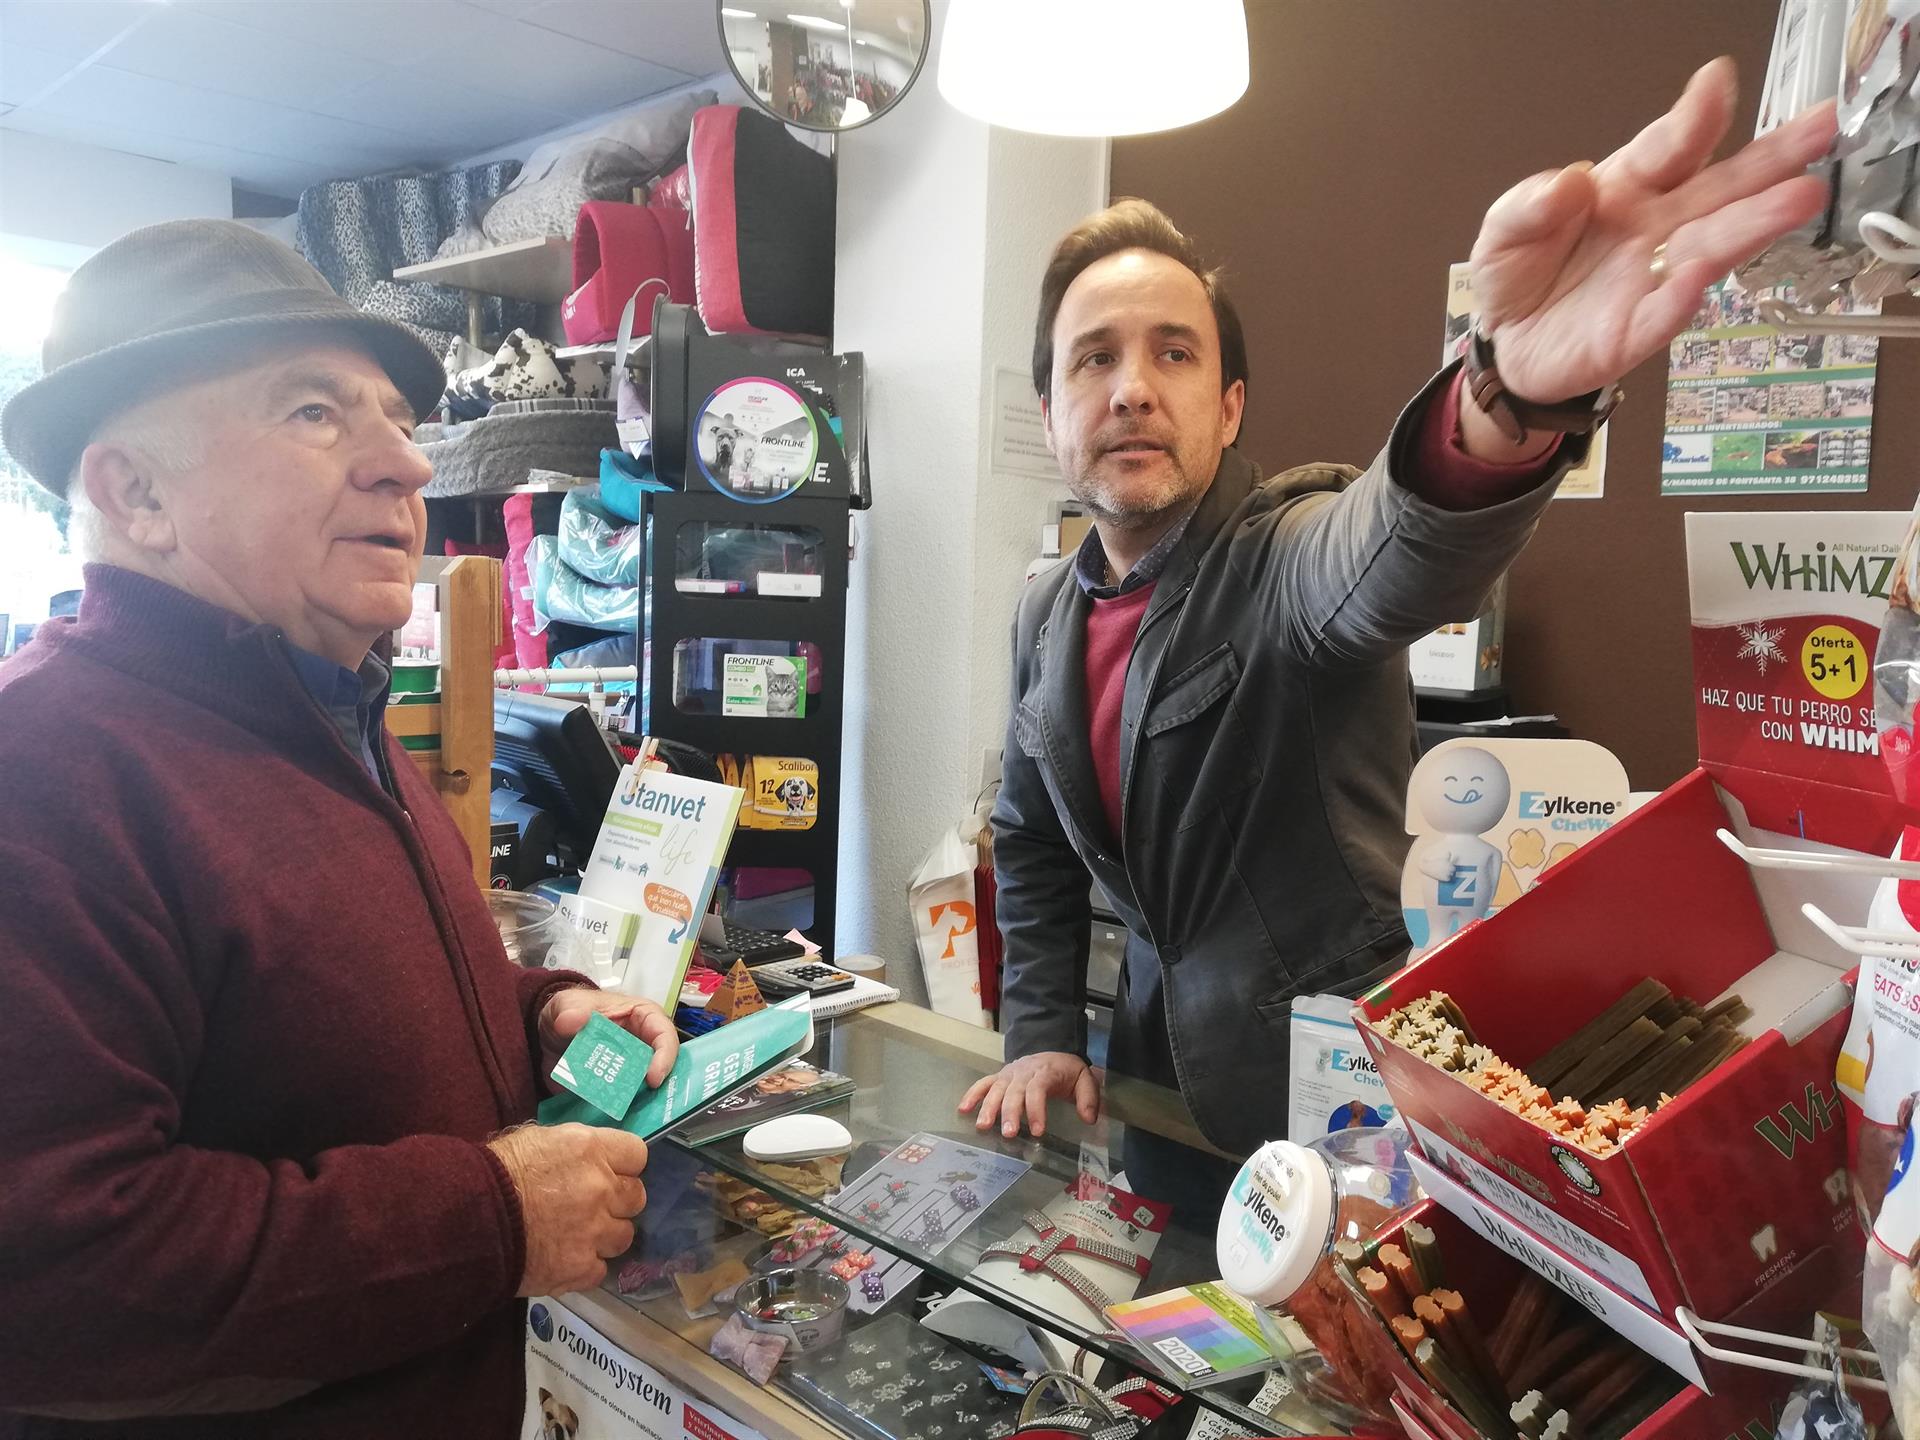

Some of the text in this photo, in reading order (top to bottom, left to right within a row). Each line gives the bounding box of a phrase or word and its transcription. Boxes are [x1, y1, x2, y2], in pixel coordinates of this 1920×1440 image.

[760, 436, 807, 449] FRONTLINE
[1715, 476, 1729, 486] DE
[1846, 543, 1879, 553] Natural
[1811, 636, 1854, 649] Oferta
[727, 656, 776, 667] FRONTLINE
[1810, 653, 1856, 683] 5+1
[1702, 687, 1730, 708] HAZ
[1735, 690, 1766, 713] QUE
[1771, 695, 1793, 716] TU
[1800, 699, 1853, 727] PERRO
[1761, 719, 1793, 742] CON
[778, 760, 815, 772] Scalibor
[759, 779, 775, 795] 12
[604, 1054, 626, 1084] GRAN
[1754, 1249, 1798, 1287] FRESHENS
[1158, 1338, 1205, 1370] 2020
[557, 1324, 673, 1416] ozonosystem
